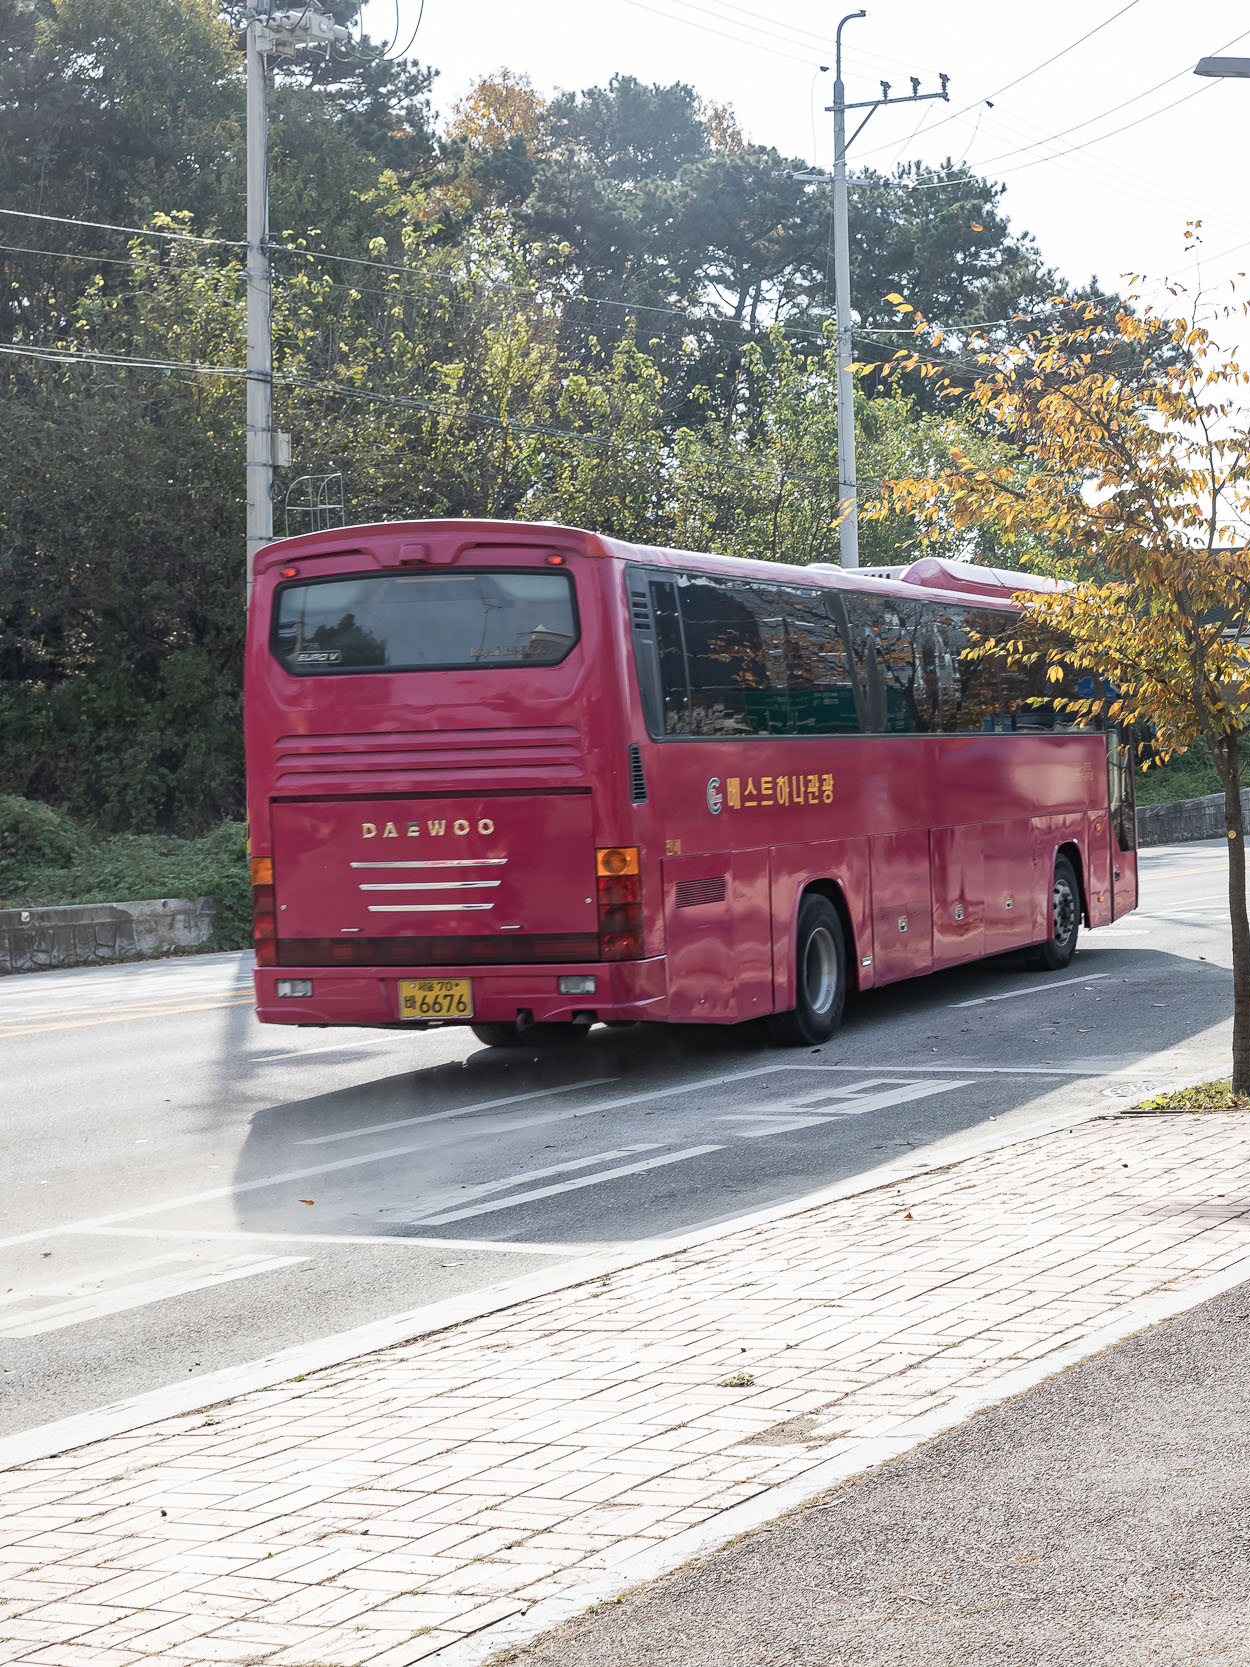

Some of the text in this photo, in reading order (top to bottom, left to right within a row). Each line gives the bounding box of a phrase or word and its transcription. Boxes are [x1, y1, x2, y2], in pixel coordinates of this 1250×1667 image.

[726, 773, 835, 810] 베스트하나관광
[361, 818, 496, 839] DAEWOO
[437, 981, 453, 992] 70
[419, 994, 468, 1014] 6676
